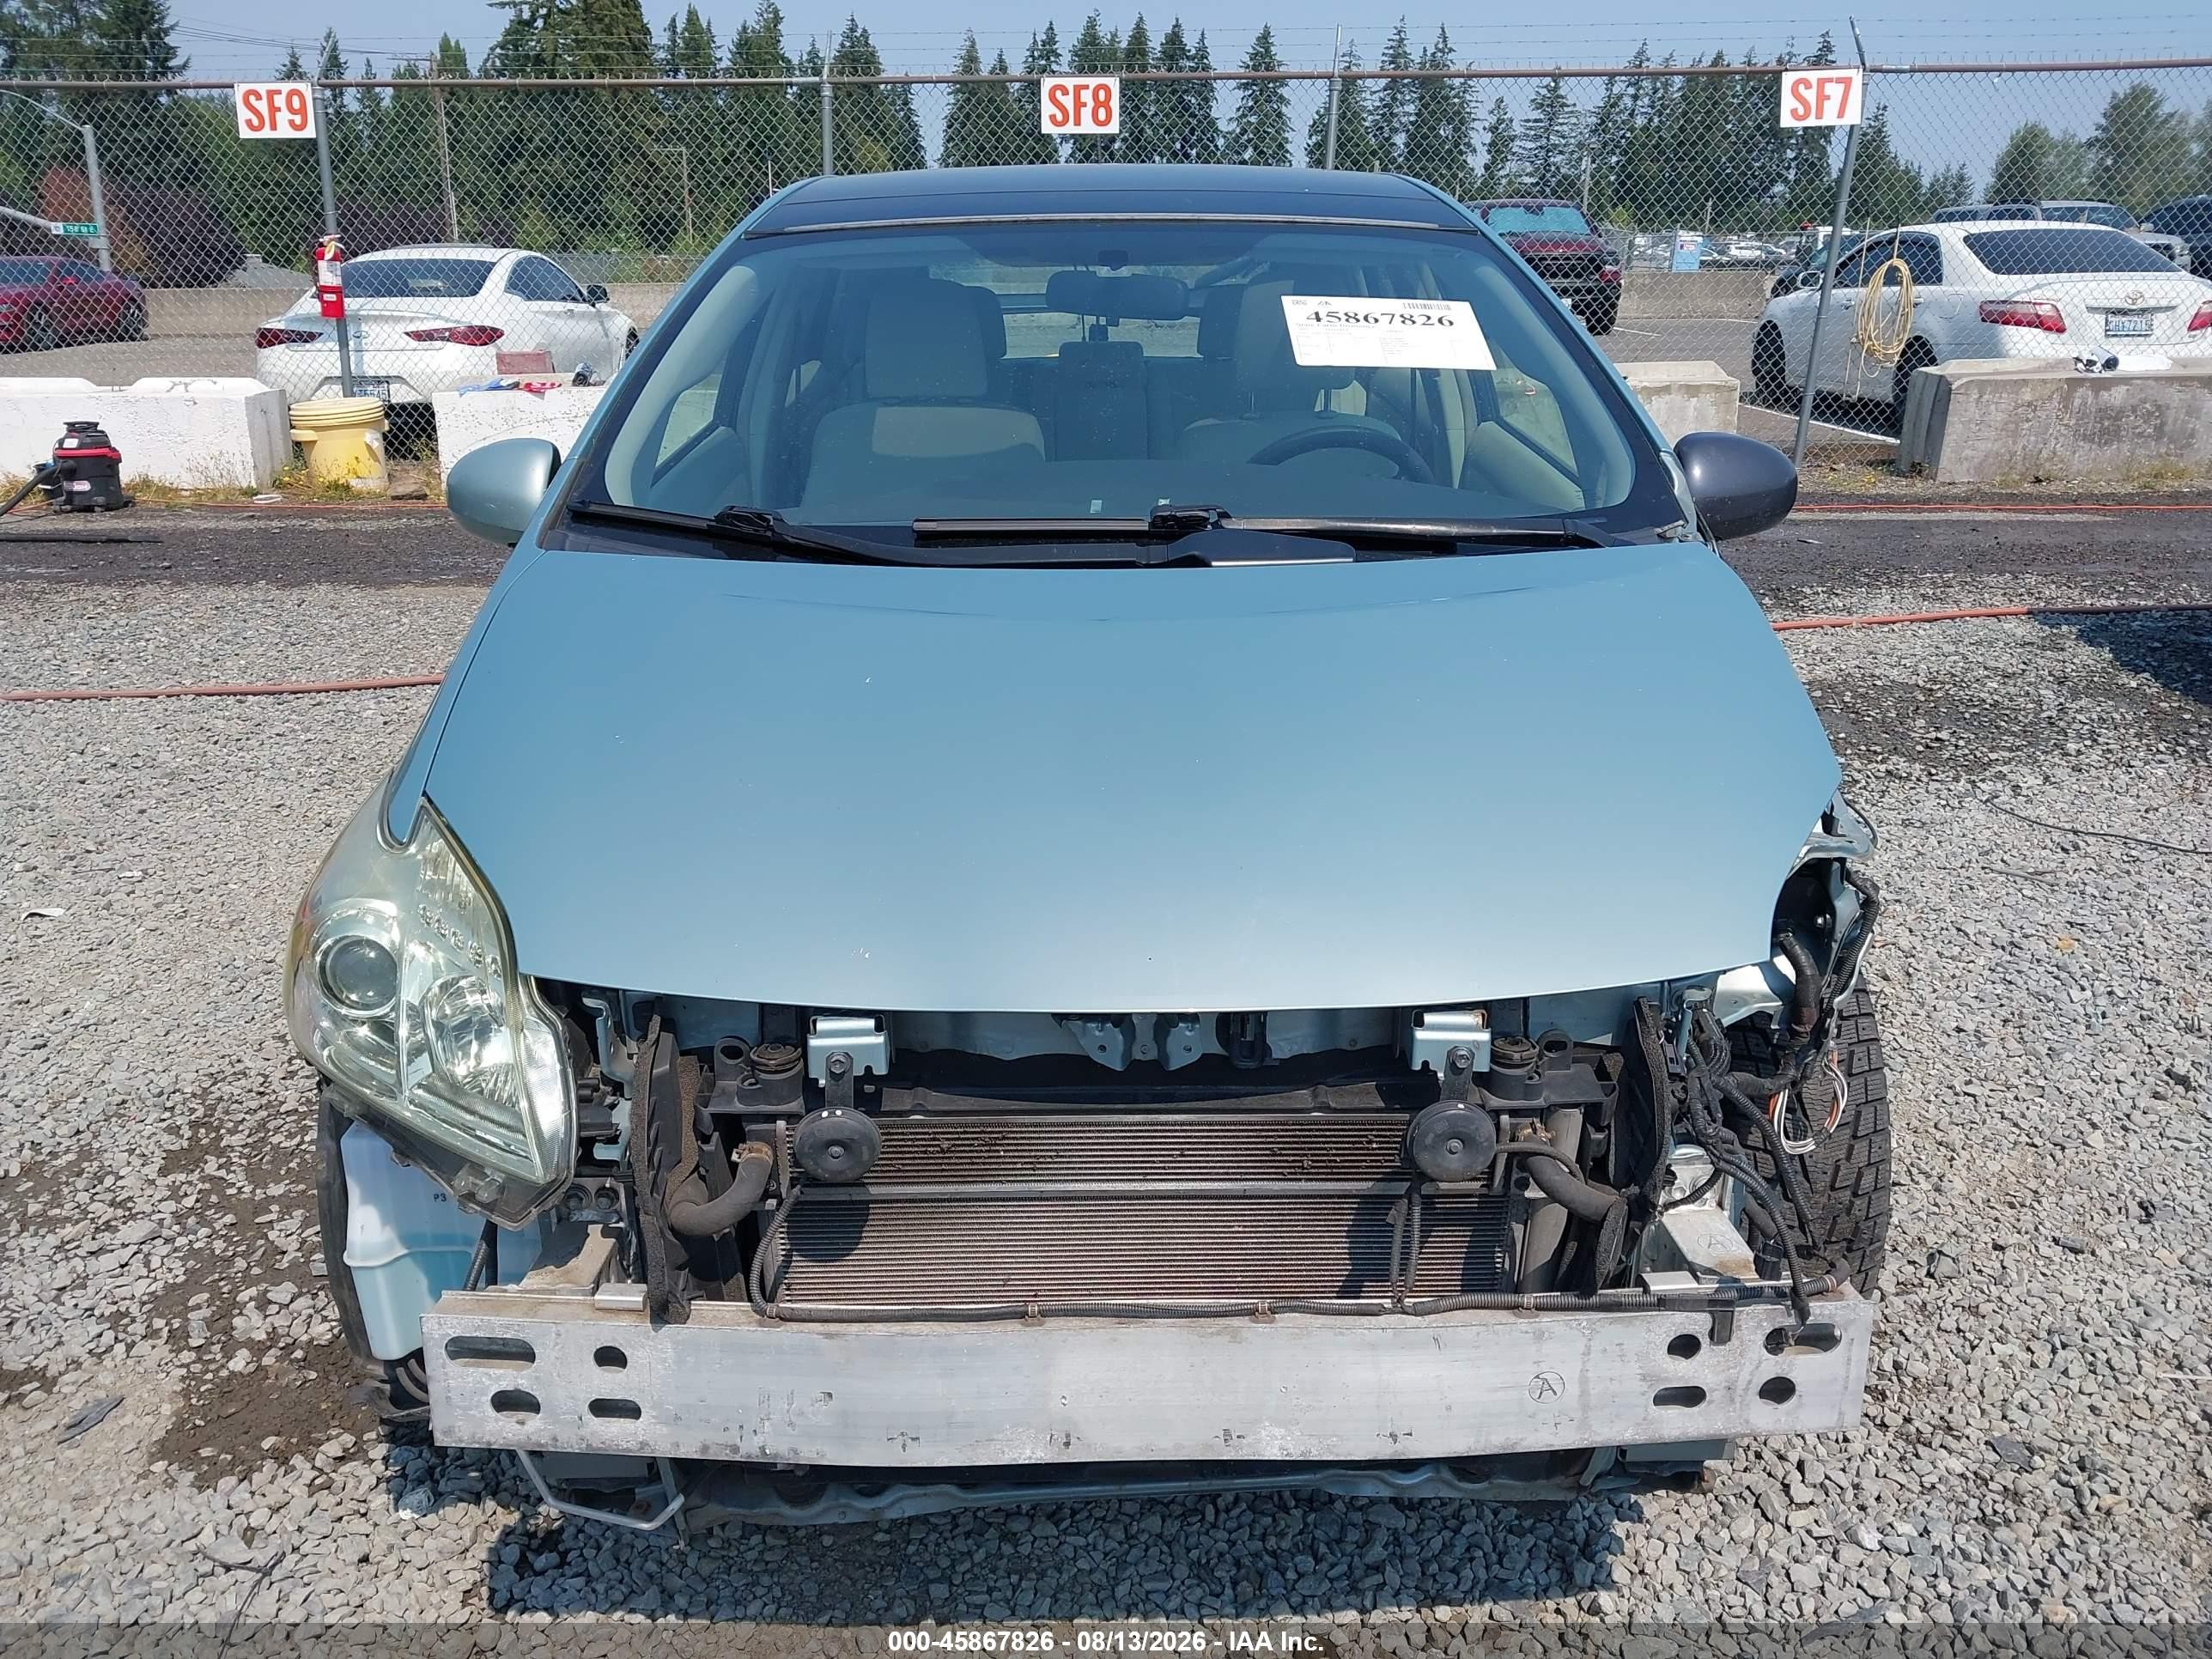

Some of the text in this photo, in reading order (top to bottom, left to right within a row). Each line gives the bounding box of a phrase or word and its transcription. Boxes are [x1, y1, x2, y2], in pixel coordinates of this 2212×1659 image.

[242, 88, 308, 131] SF9
[1048, 83, 1113, 127] SF8
[1790, 76, 1853, 122] SF7
[1306, 311, 1455, 327] 45867826
[433, 1193, 447, 1202] P3
